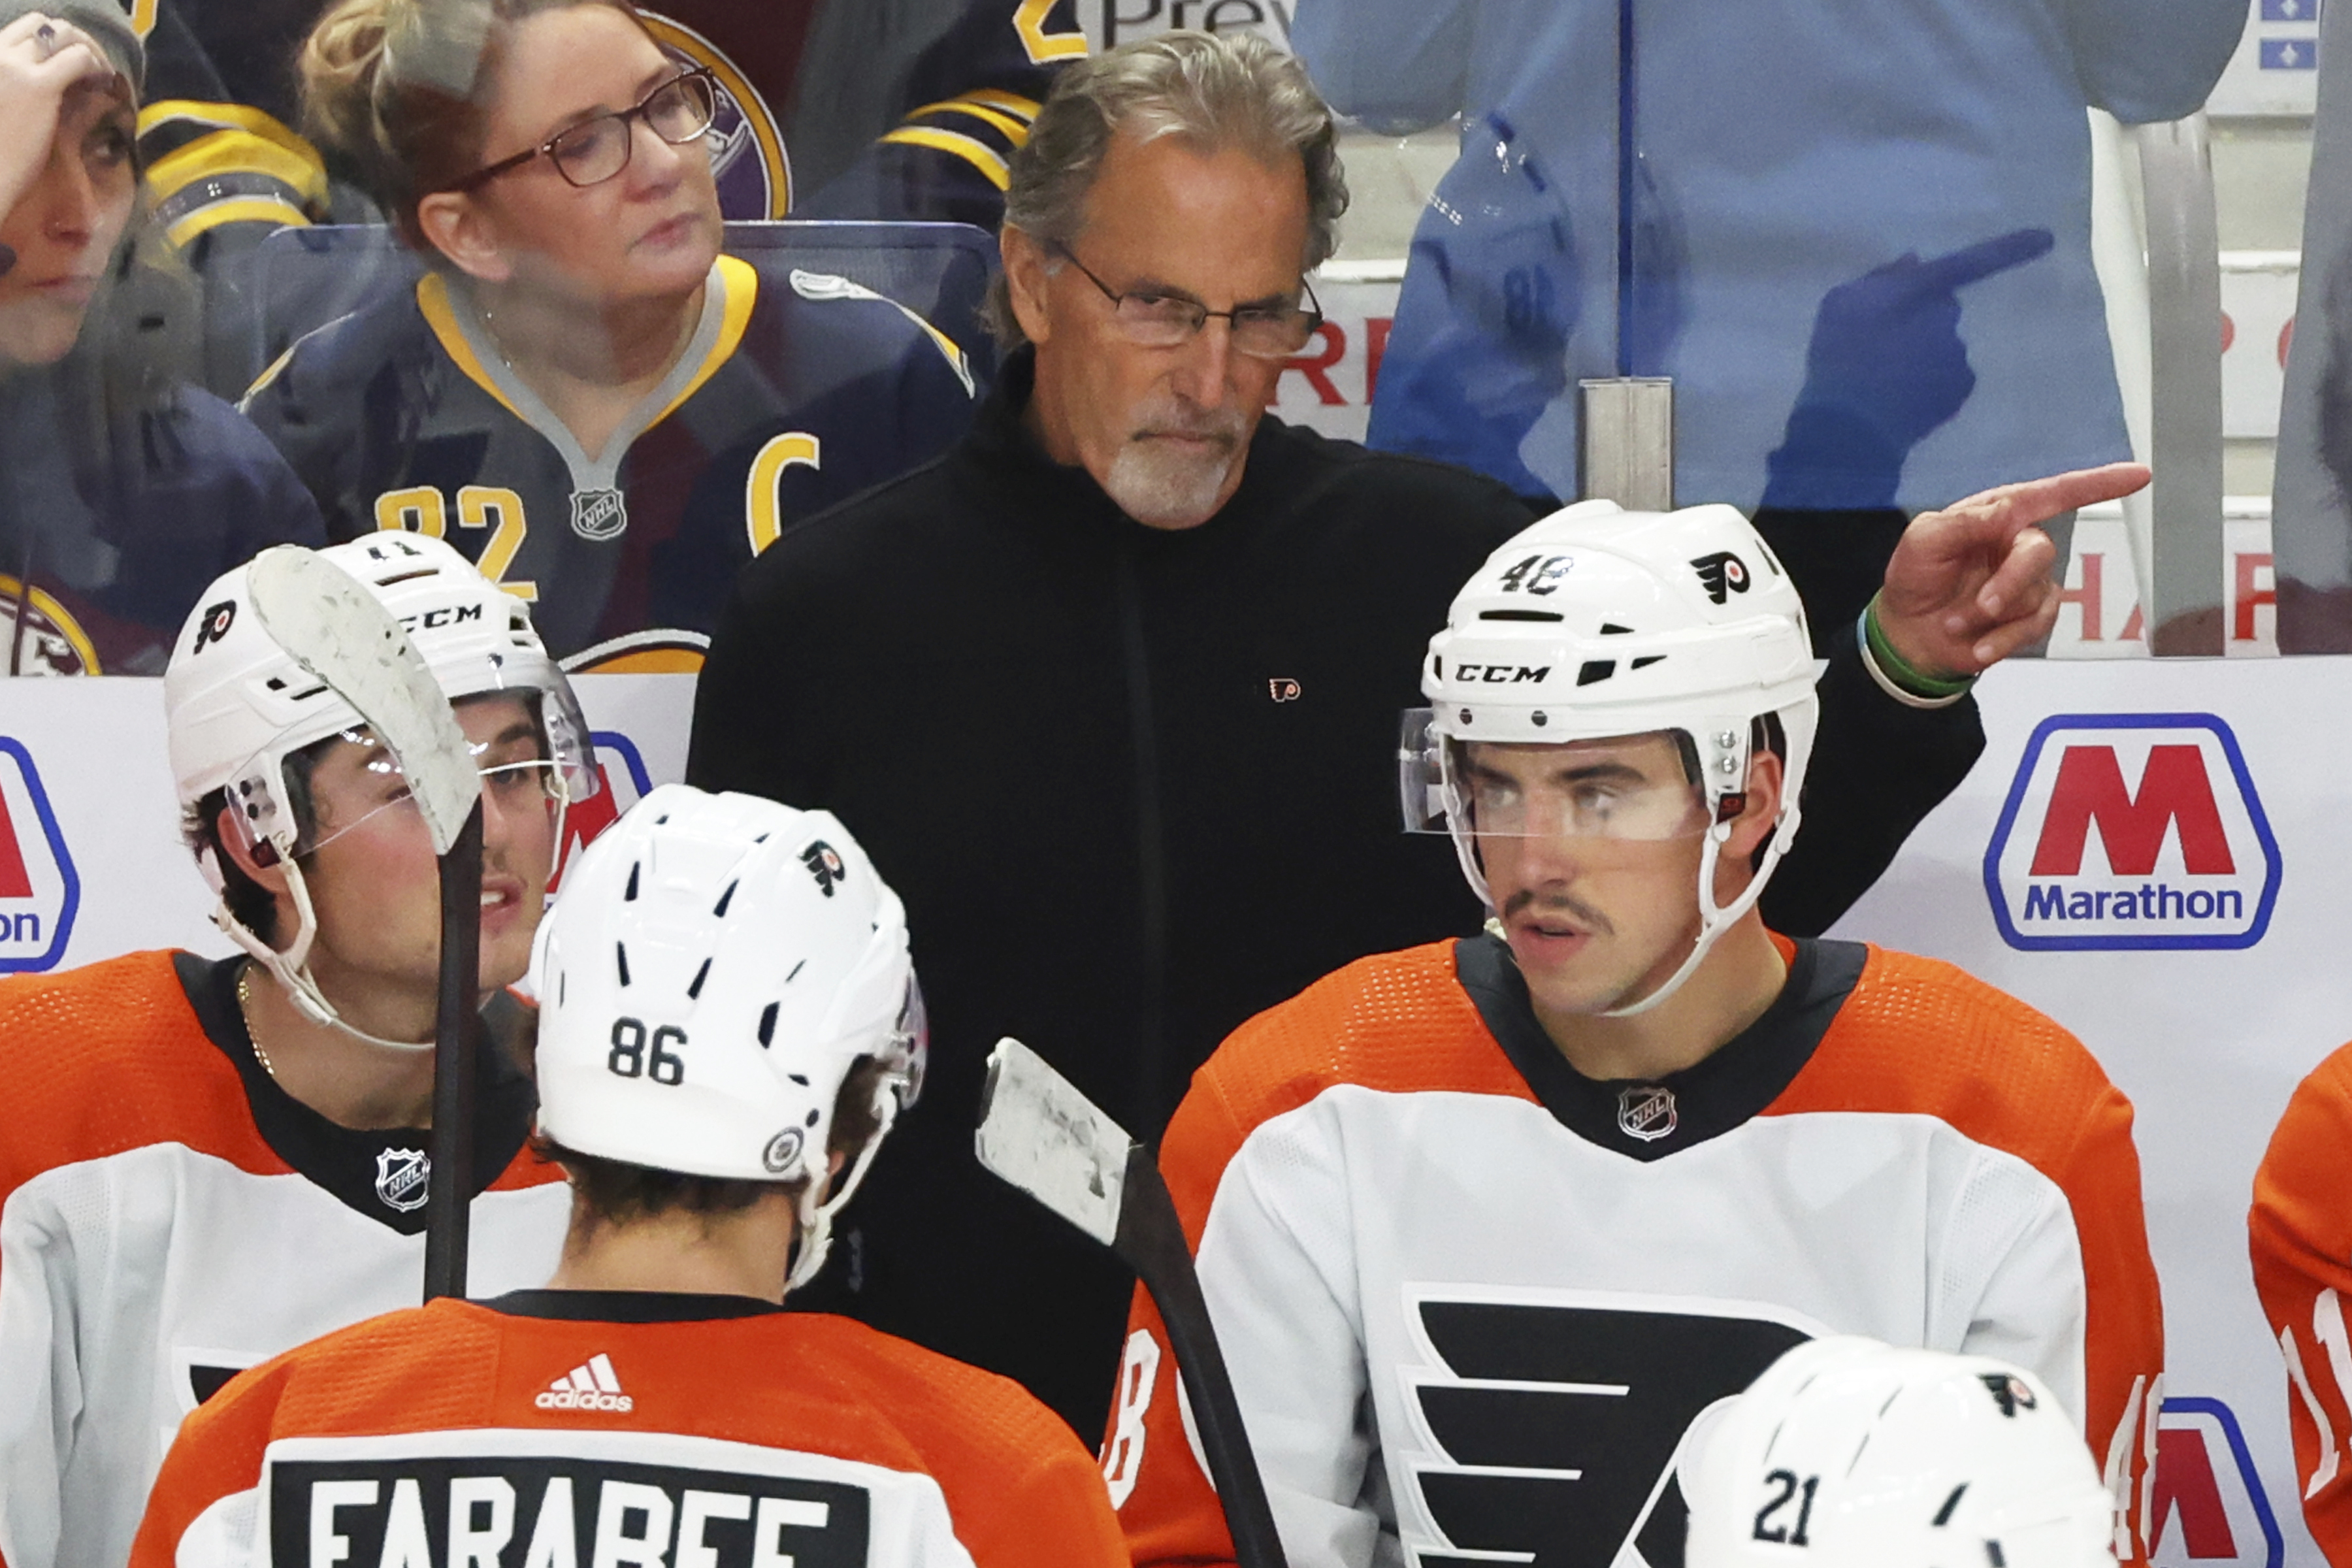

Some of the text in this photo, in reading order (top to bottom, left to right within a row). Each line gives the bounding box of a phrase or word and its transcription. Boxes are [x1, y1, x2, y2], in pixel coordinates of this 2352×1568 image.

[1456, 664, 1552, 683] CCM
[2024, 884, 2242, 920] Marathon
[608, 1017, 688, 1086] 86
[534, 1388, 633, 1413] adidas
[1752, 1468, 1820, 1547] 21
